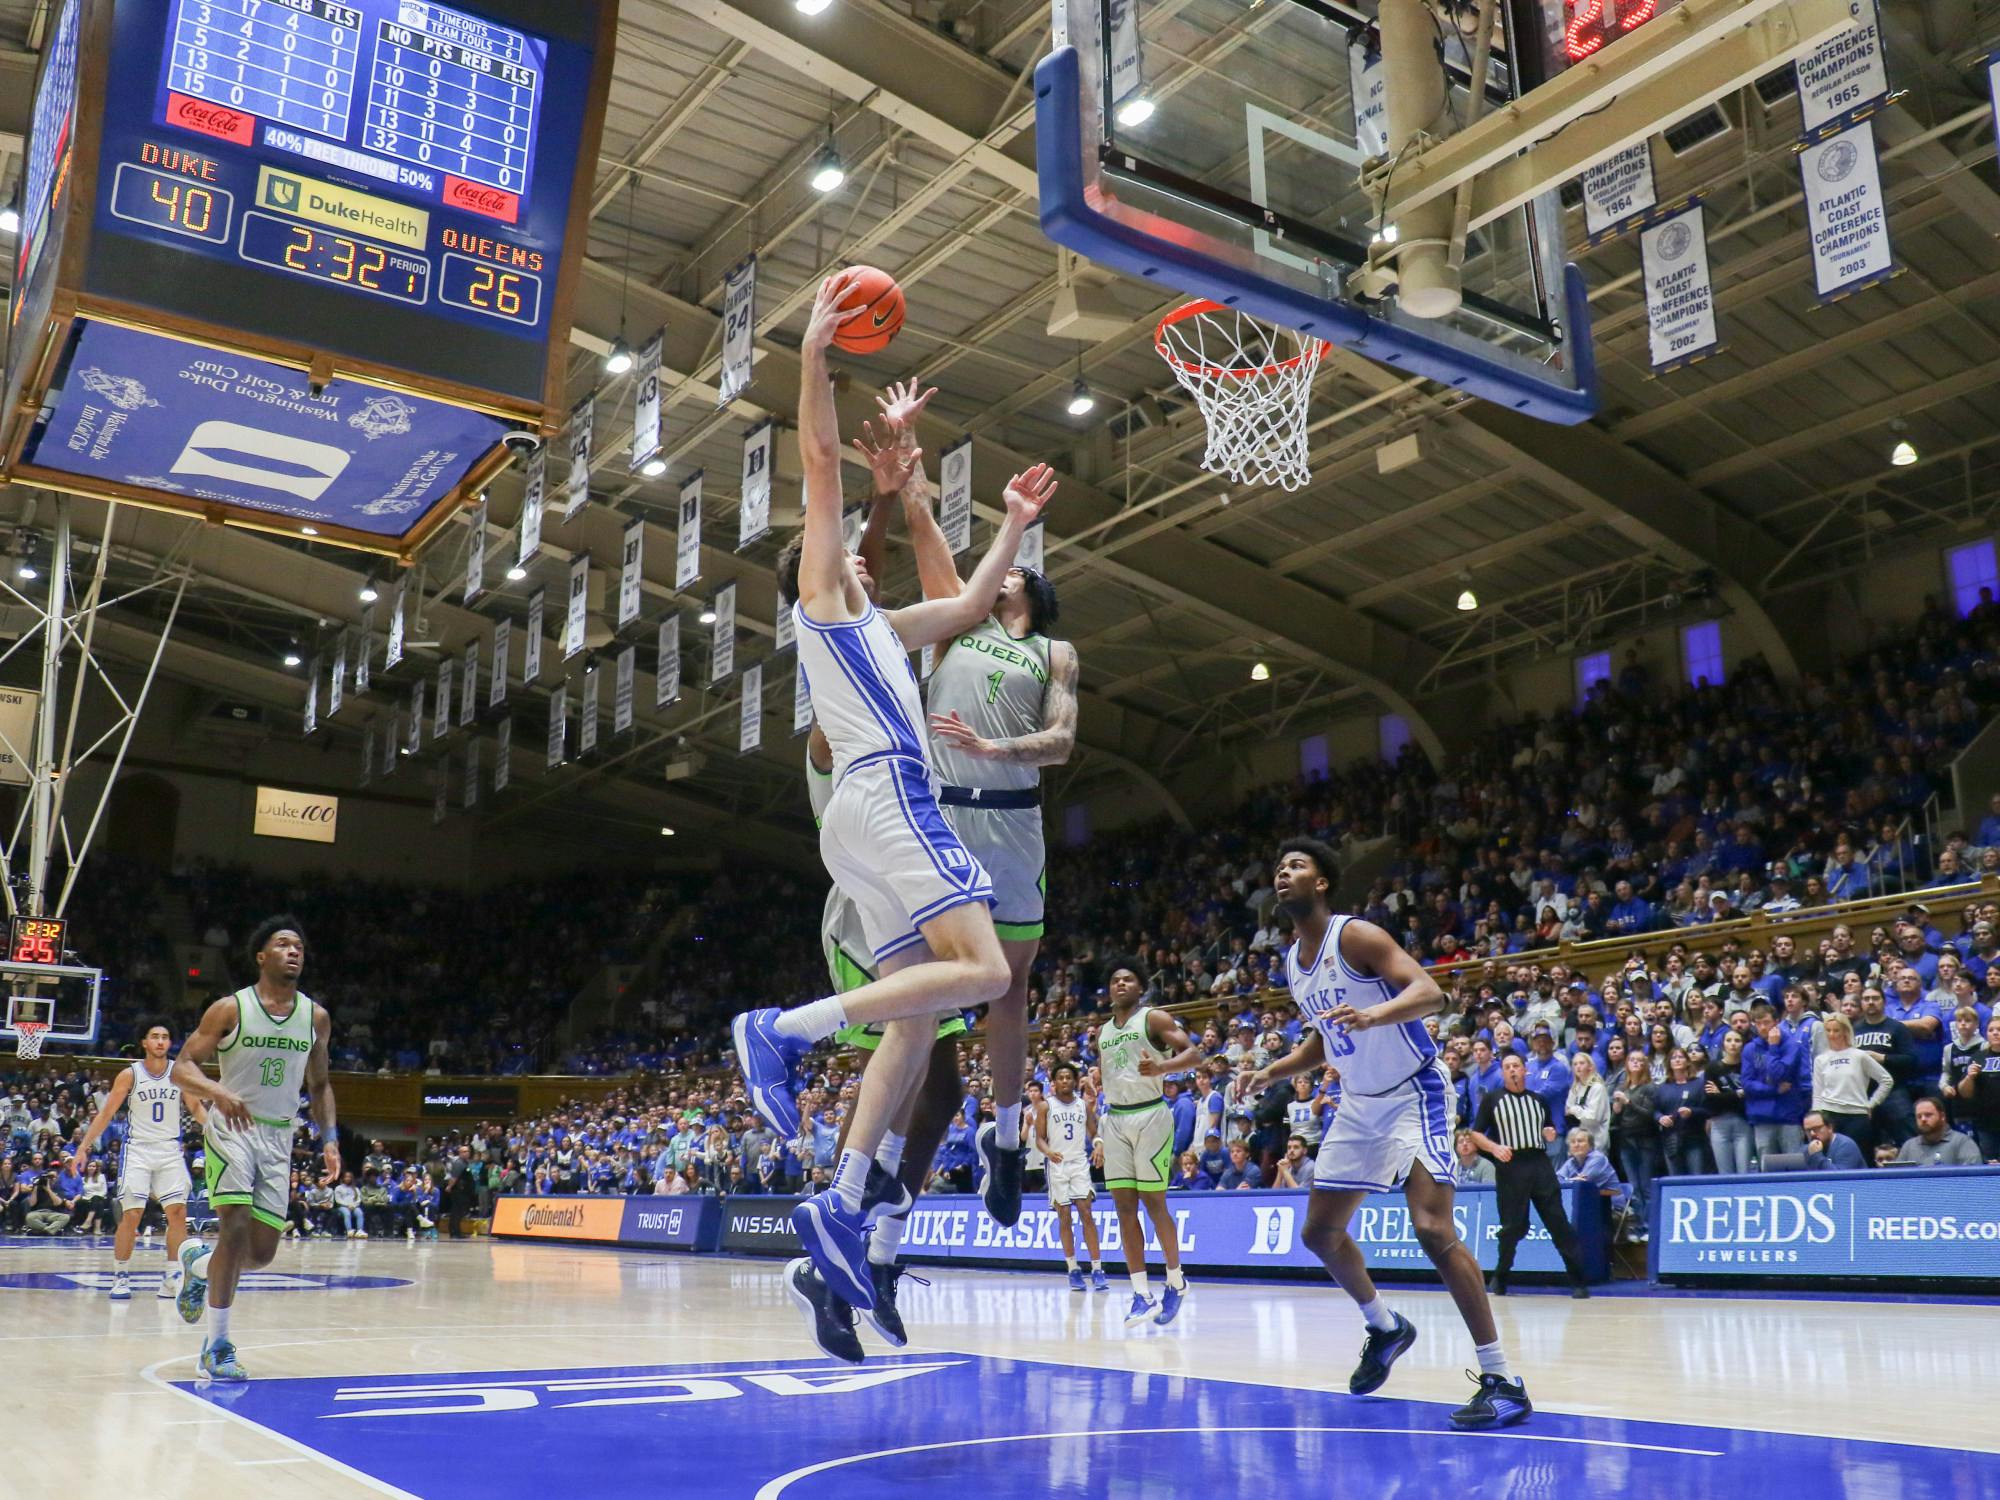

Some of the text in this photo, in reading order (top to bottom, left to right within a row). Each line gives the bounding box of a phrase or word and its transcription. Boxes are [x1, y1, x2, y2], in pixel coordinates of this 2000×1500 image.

[286, 14, 299, 31] 4
[331, 27, 344, 45] 0
[324, 5, 356, 26] FLS
[438, 12, 514, 46] TIMEOUTS 3
[200, 5, 338, 66] 3 4 0 1
[431, 22, 513, 59] TEAM FOULS 6
[1799, 25, 1876, 75] CONFERENCE
[194, 27, 338, 88] 5 2 1 0
[388, 27, 530, 85] NO PTS REB FLS
[1804, 43, 1874, 88] CHAMPIONS
[188, 49, 335, 110] 13 1 1 0
[394, 47, 517, 103] 1 0 1 1
[1812, 64, 1871, 99] REGULAR SEASON
[184, 71, 330, 131] 15 0 1 1
[385, 66, 515, 123] 10 3 3 1
[1827, 84, 1860, 110] 1965
[385, 88, 516, 144] 11 3 0 0
[1358, 102, 1384, 127] FINAL
[379, 109, 510, 165] 13 11 4 1
[141, 142, 219, 182] DUKE
[267, 129, 433, 191] 40% FREE THROWS 50%
[373, 129, 511, 186] 32 0 1 0
[1584, 144, 1647, 182] CONFERENCE
[1588, 159, 1646, 195] CHAMPIONS
[152, 180, 213, 232] 40
[1606, 195, 1632, 217] 1964
[1819, 184, 1867, 212] ATLANTIC
[1828, 201, 1861, 223] COAST
[309, 195, 418, 238] DukeHealth
[1815, 207, 1881, 244] CONFERENCE
[443, 228, 544, 271] QUEENS
[1820, 222, 1880, 257] CHAMPIONS
[1830, 241, 1871, 263] TOURNAMENT
[284, 226, 386, 290] 2:32
[389, 256, 427, 274] PERIOD
[1839, 259, 1866, 277] 2003
[407, 274, 415, 293] 1
[468, 265, 521, 315] 26
[1655, 263, 1697, 289] ATLANTIC
[1663, 279, 1692, 298] COAST
[1651, 285, 1710, 316] CONFERENCE
[1655, 300, 1709, 329] CHAMPIONS
[727, 303, 749, 345] 24
[1670, 334, 1696, 351] 2002
[194, 360, 239, 380] Club
[240, 371, 285, 395] Golf
[179, 370, 340, 422] Washington Duke
[638, 376, 656, 408] 43
[960, 635, 1046, 684] QUEENS
[986, 670, 1005, 704] 1
[258, 801, 335, 823] Duke 100
[26, 921, 60, 938] 2:32
[18, 936, 54, 963] 25
[242, 1036, 309, 1052] QUEENS
[1855, 1032, 1892, 1047] DUKE
[259, 1057, 287, 1087] 13
[1829, 1058, 1850, 1066] DUKE
[138, 1088, 178, 1101] DUKE
[424, 1095, 468, 1107] Smithfield
[152, 1102, 164, 1122] 0
[1053, 1112, 1084, 1124] DUKE
[1064, 1123, 1073, 1140] 3
[525, 1203, 576, 1231] Continental
[638, 1212, 669, 1230] TRUIST
[1668, 1193, 1836, 1244] REEDS
[1868, 1216, 2000, 1241] REEDS.co
[1697, 1250, 1798, 1262] JEWELERS
